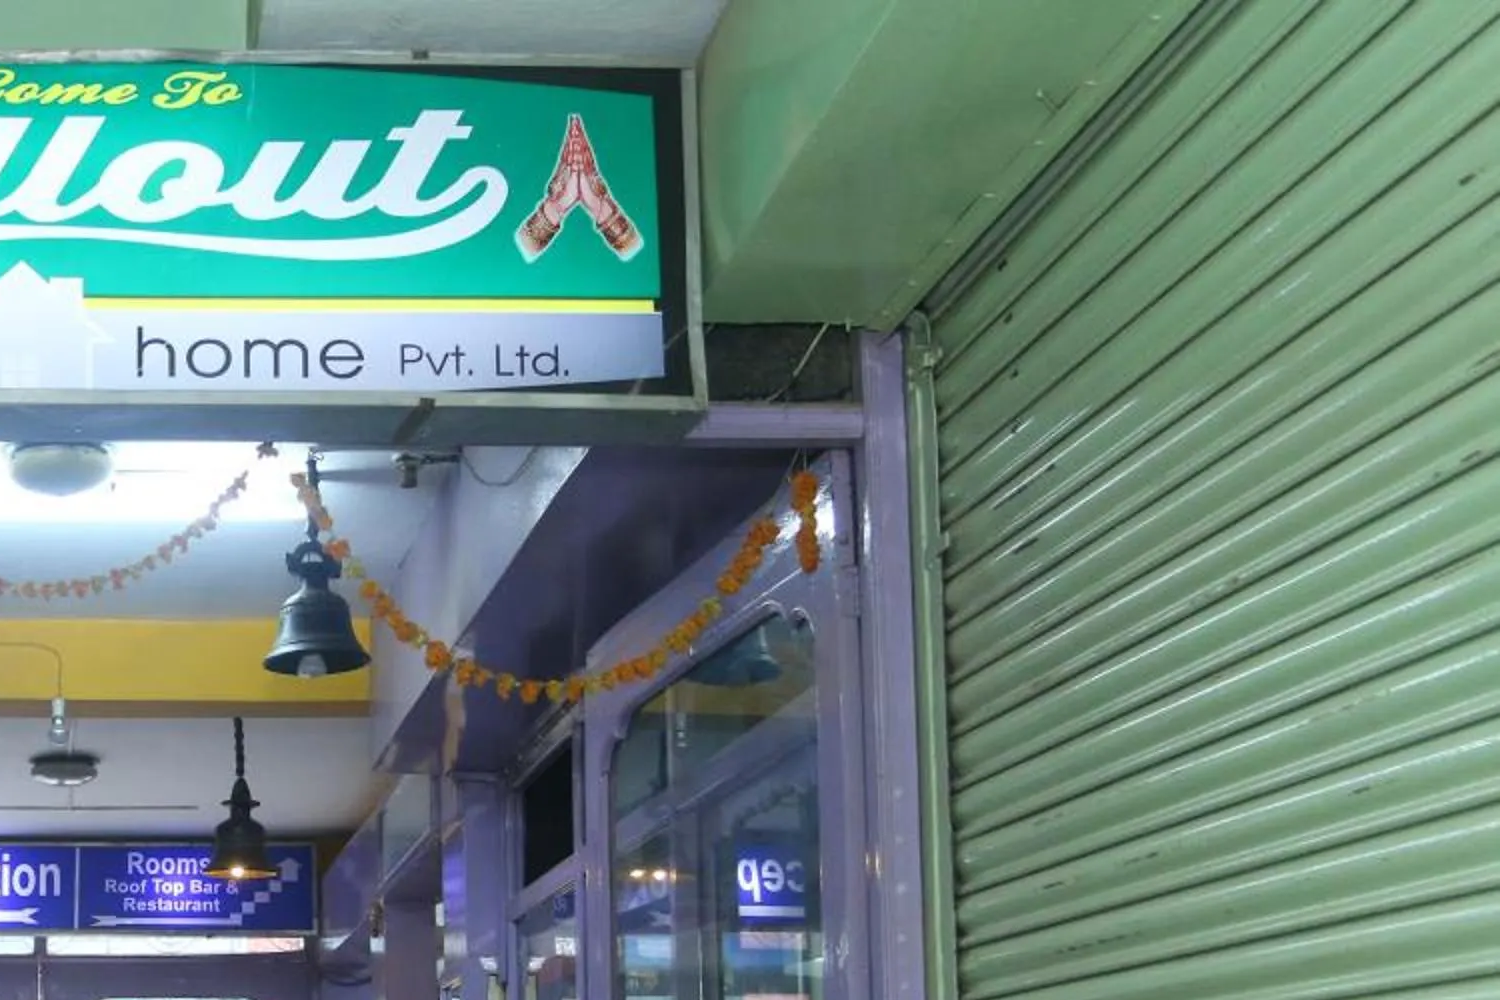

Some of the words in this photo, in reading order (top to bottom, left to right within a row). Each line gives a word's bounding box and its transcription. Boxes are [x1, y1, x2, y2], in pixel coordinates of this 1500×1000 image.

[152, 71, 243, 109] To
[136, 325, 365, 379] home
[399, 343, 474, 378] Pvt.
[494, 343, 570, 378] Ltd.
[104, 879, 148, 894] Roof
[152, 878, 184, 896] Top
[189, 879, 221, 895] Bar
[225, 879, 239, 895] &
[123, 897, 221, 912] Restaurant
